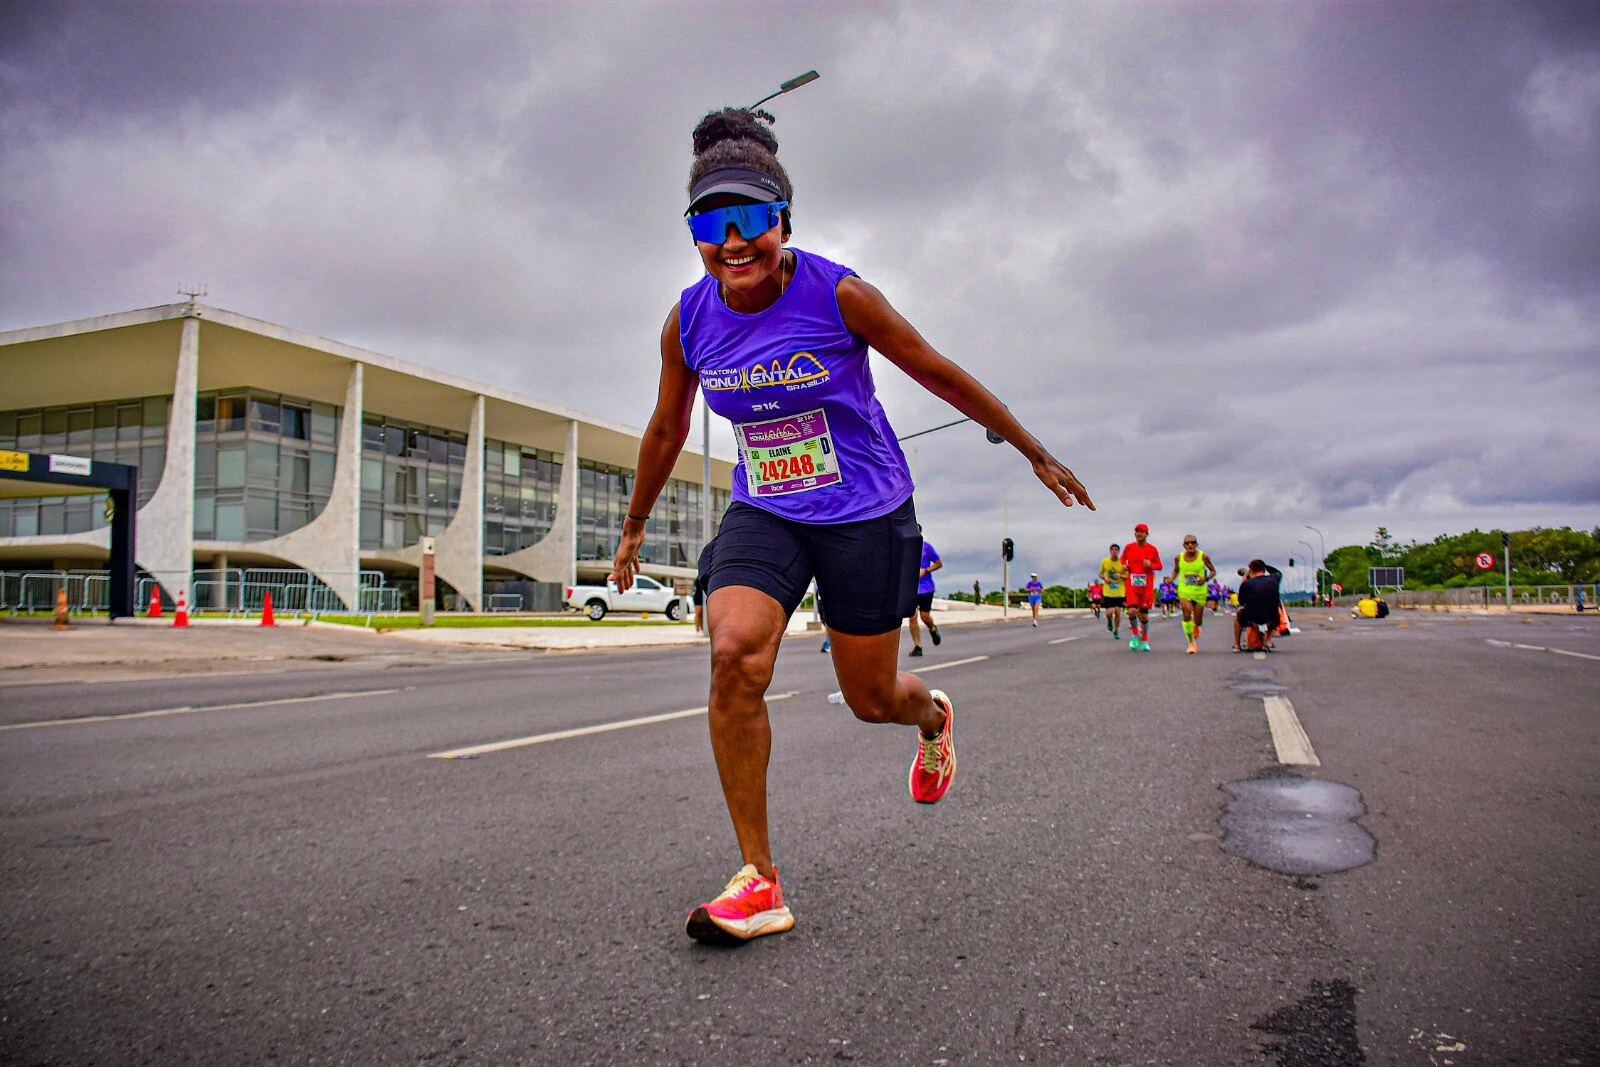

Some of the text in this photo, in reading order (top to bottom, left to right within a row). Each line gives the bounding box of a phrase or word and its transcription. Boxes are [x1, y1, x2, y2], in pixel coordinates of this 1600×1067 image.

[701, 368, 738, 376] MARATONA
[751, 401, 780, 411] 21K
[796, 414, 814, 423] 21K
[820, 437, 830, 455] D
[768, 446, 792, 458] ELAINE
[760, 454, 815, 481] 24248
